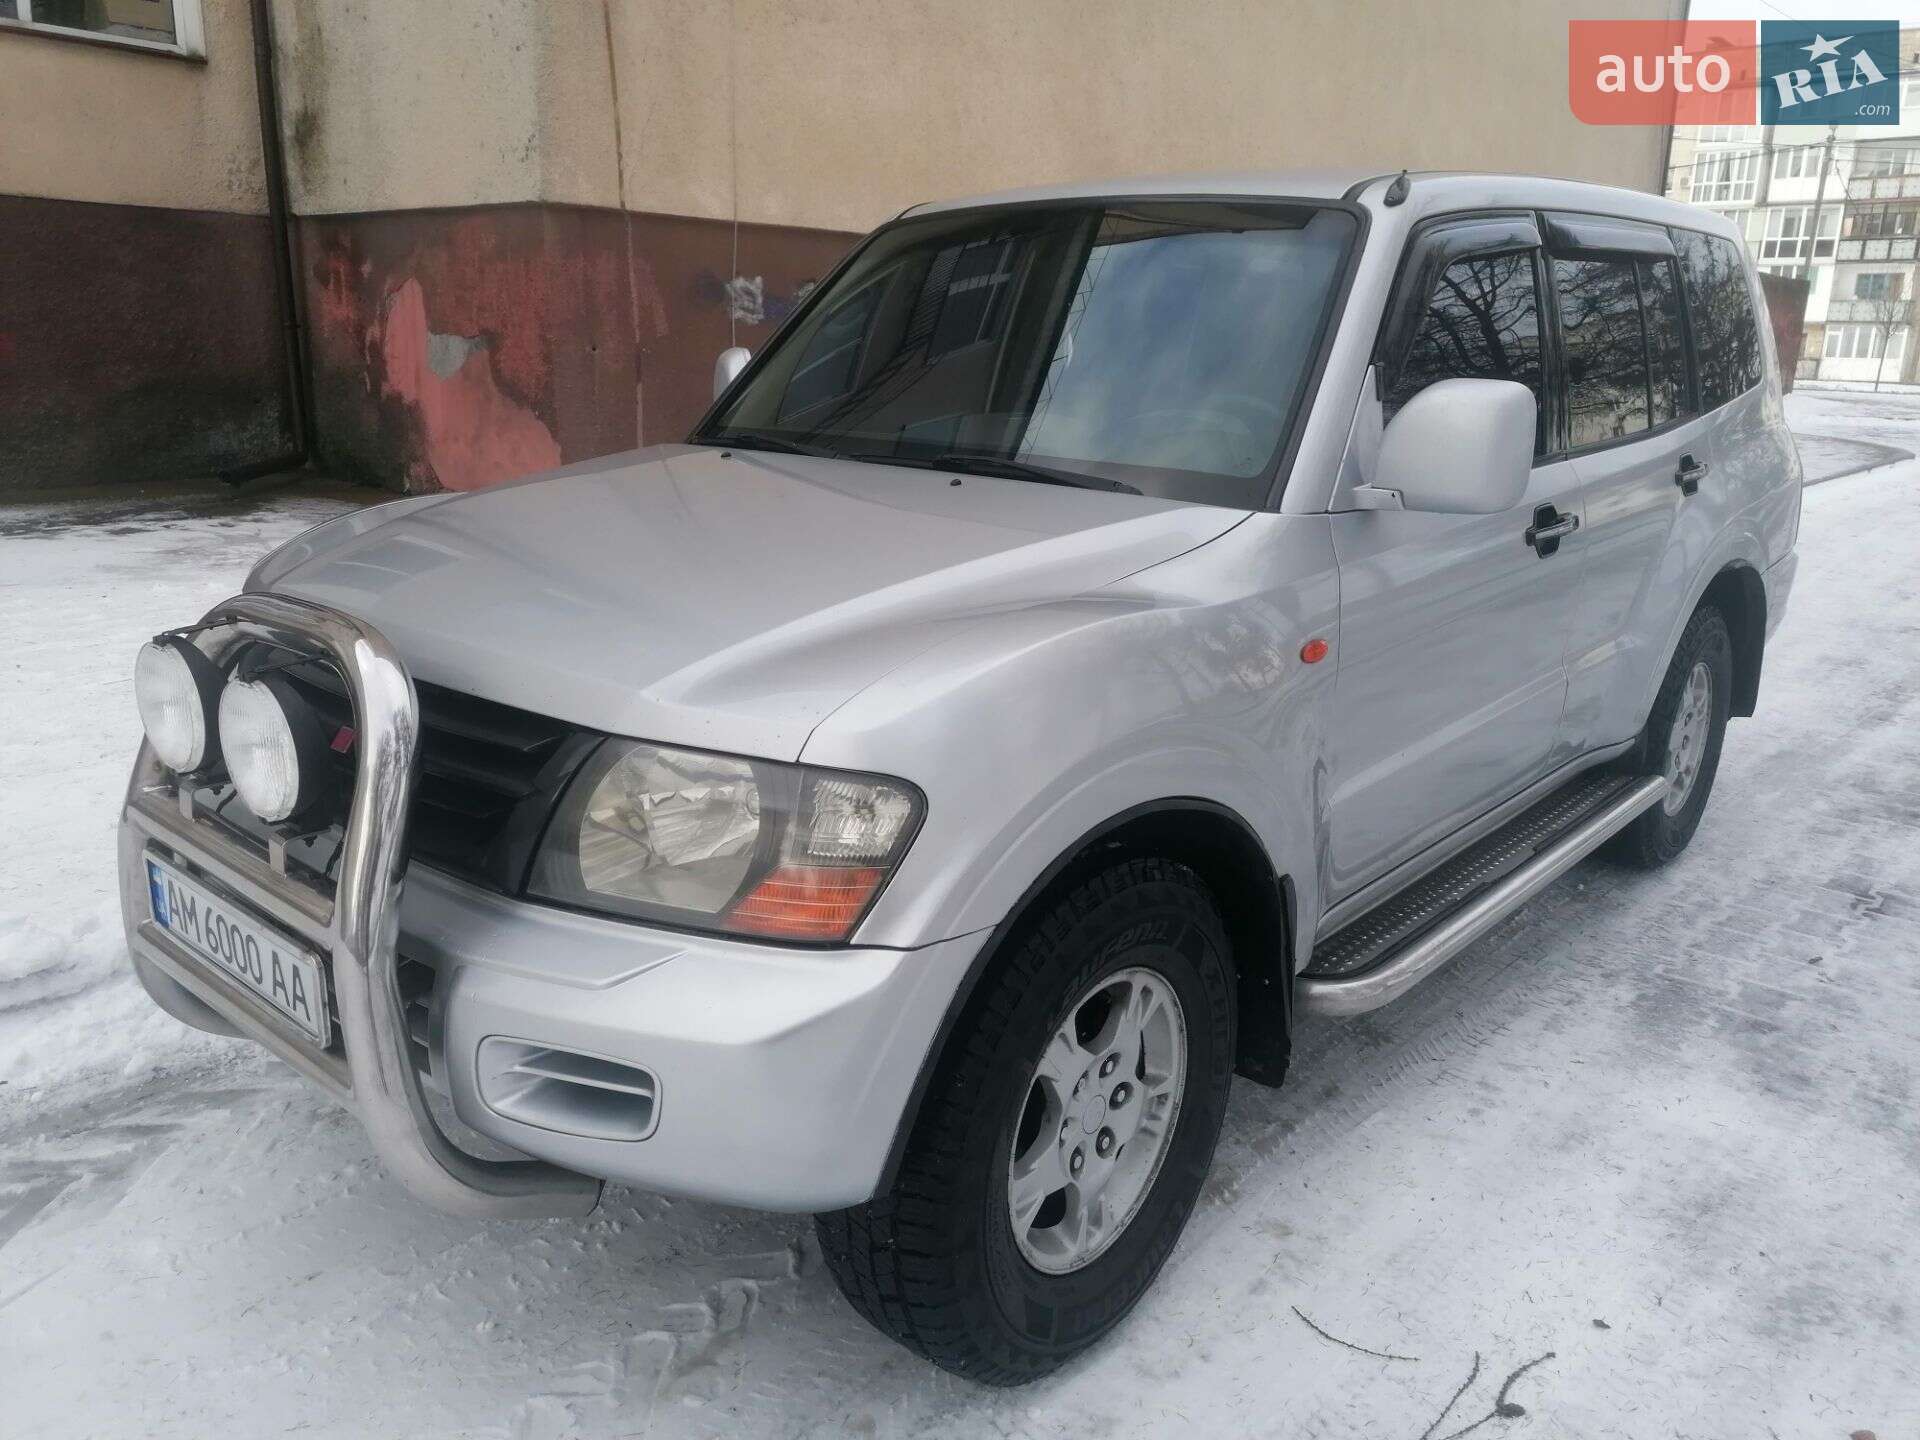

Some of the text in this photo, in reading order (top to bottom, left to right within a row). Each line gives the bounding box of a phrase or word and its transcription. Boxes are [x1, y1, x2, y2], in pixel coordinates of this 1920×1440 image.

[167, 879, 311, 1022] AM 6000 AA
